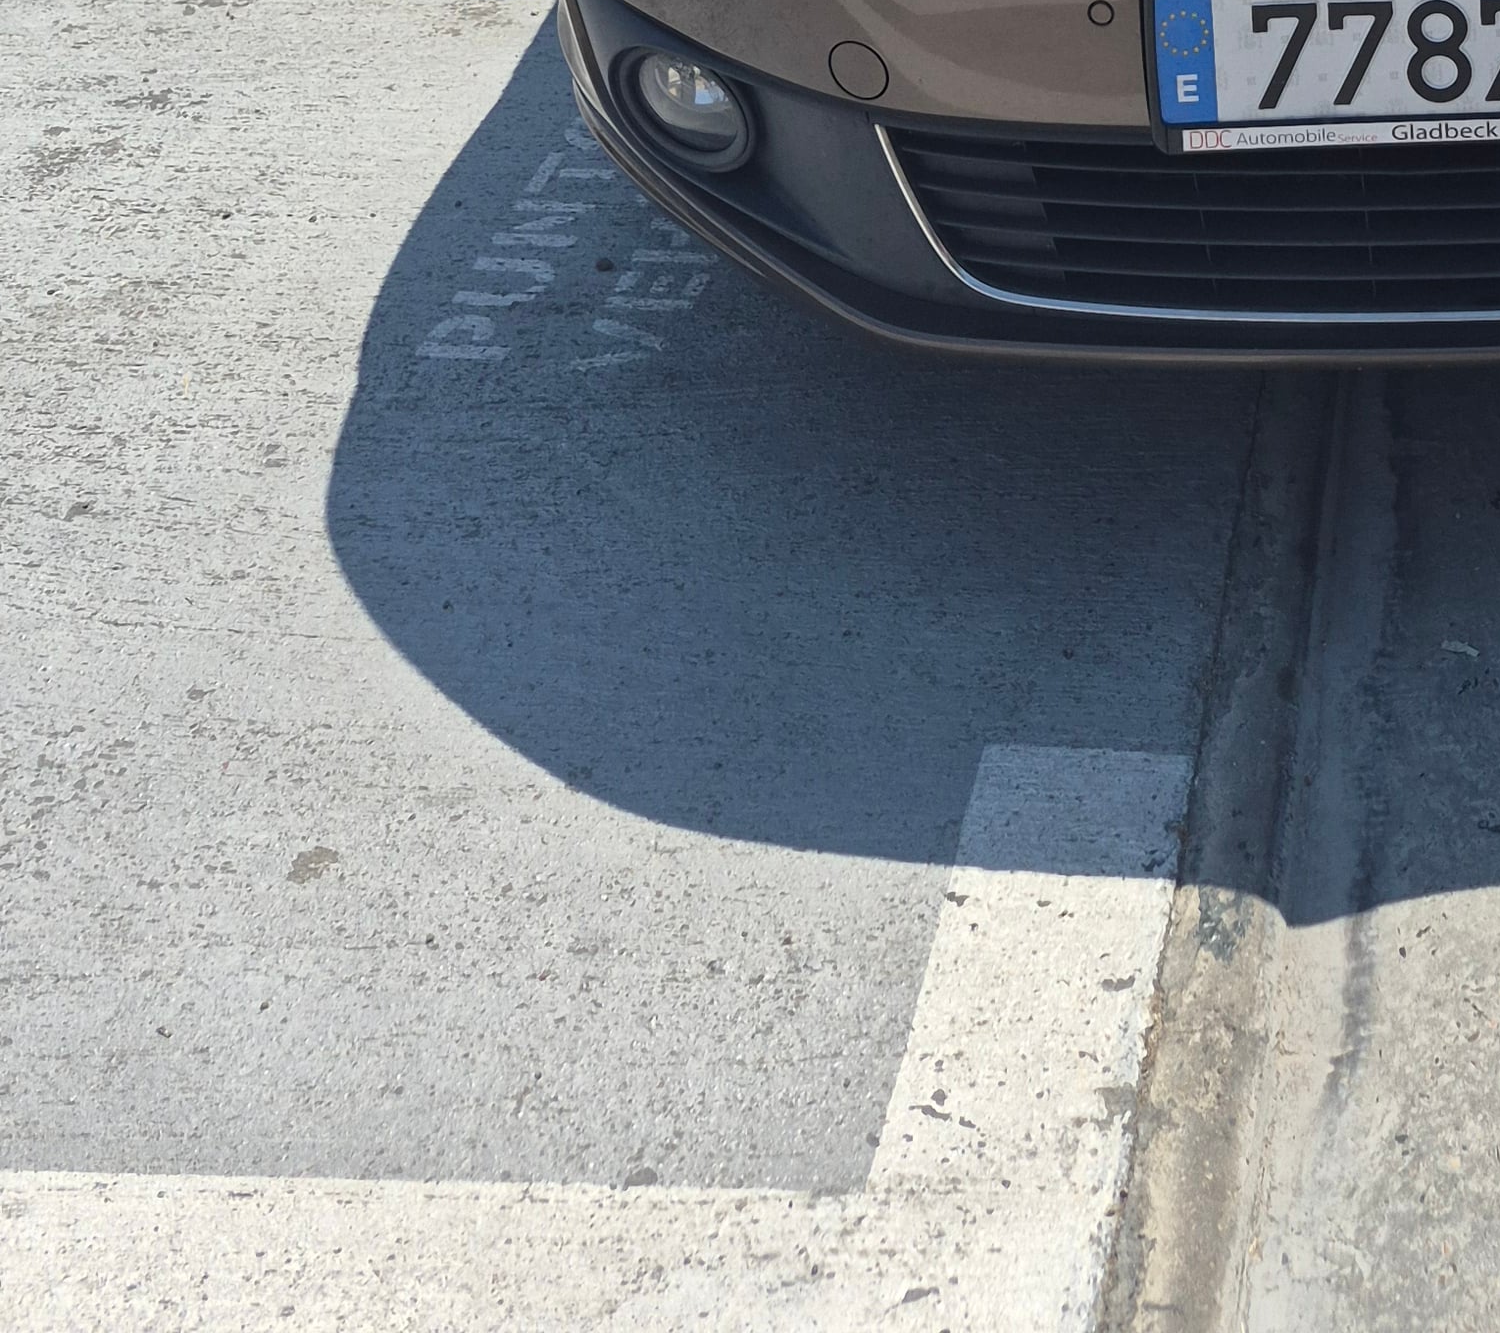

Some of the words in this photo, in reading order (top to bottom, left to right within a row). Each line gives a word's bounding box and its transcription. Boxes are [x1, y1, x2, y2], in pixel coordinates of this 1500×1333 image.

[1176, 74, 1199, 103] E
[1188, 130, 1232, 149] DDC
[1236, 128, 1336, 146] Automobile
[1337, 132, 1378, 144] Service
[1391, 121, 1498, 141] Gladbeck
